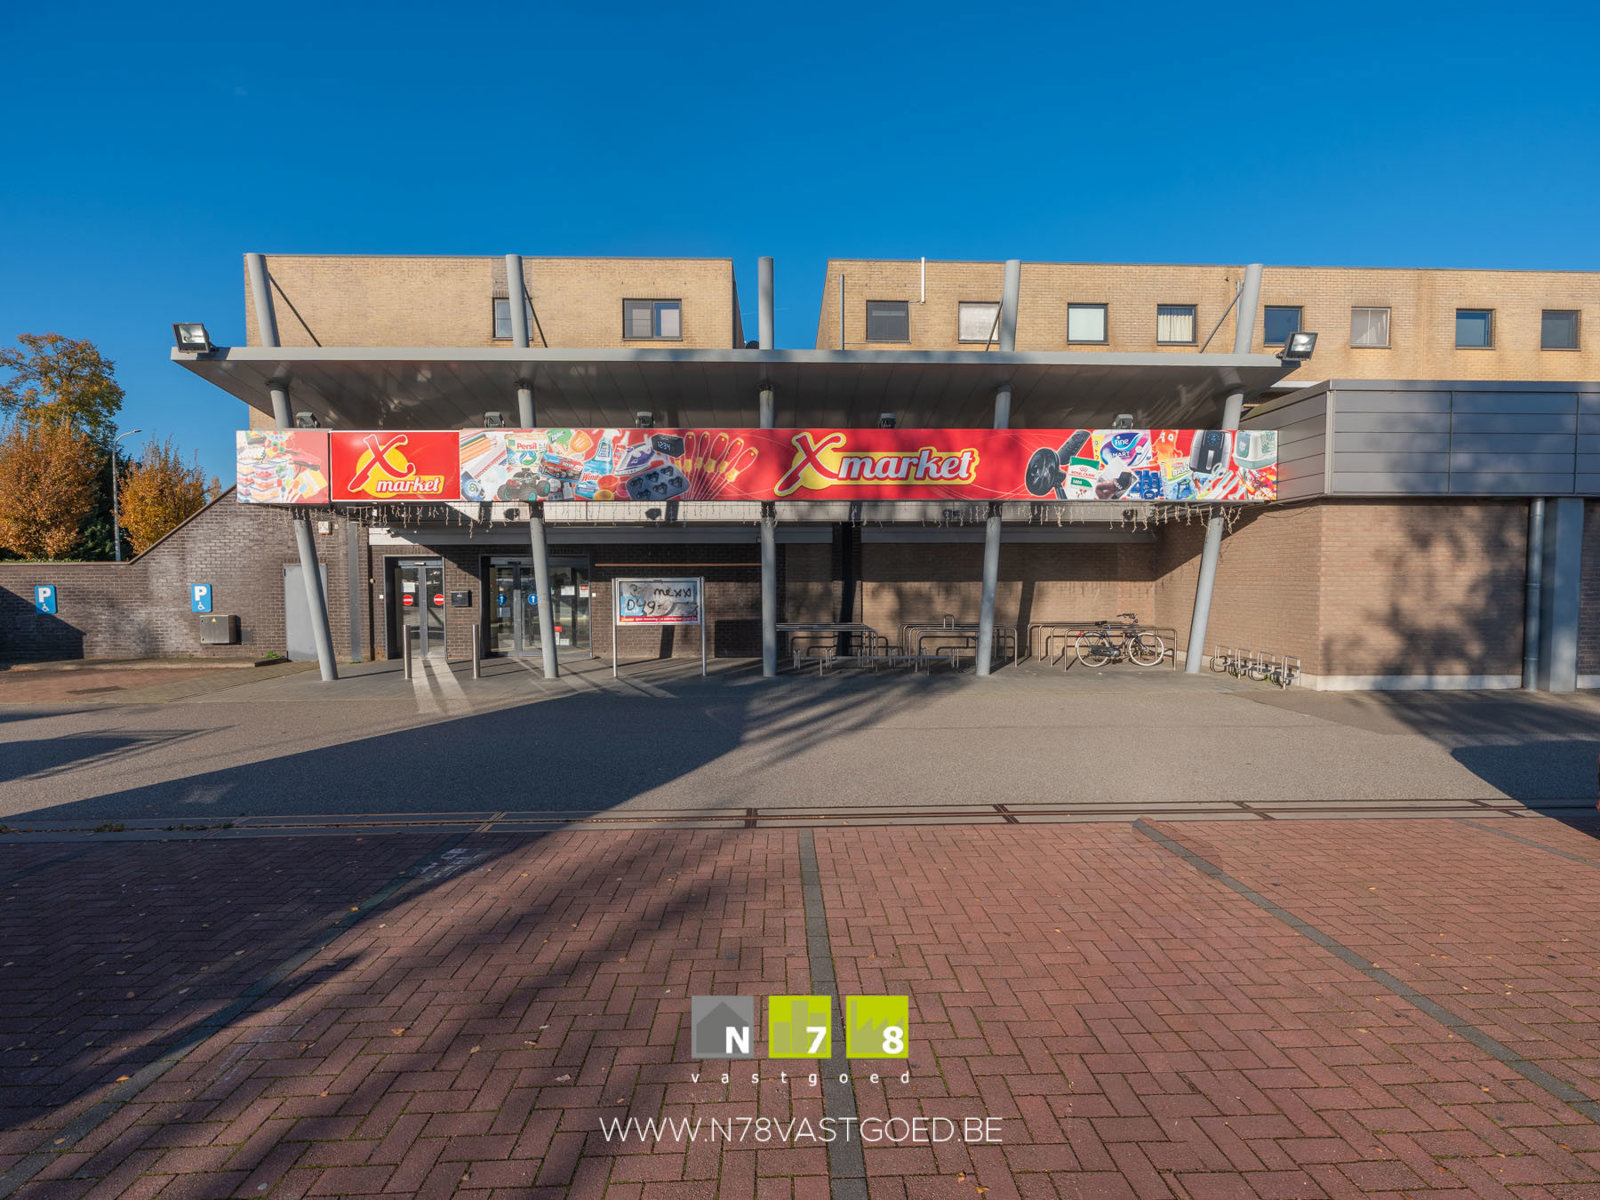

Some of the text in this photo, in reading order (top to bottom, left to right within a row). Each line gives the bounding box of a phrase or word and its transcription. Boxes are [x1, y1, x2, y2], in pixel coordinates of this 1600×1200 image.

[838, 449, 975, 480] market
[376, 477, 440, 492] market
[38, 587, 52, 603] P
[194, 585, 208, 601] P
